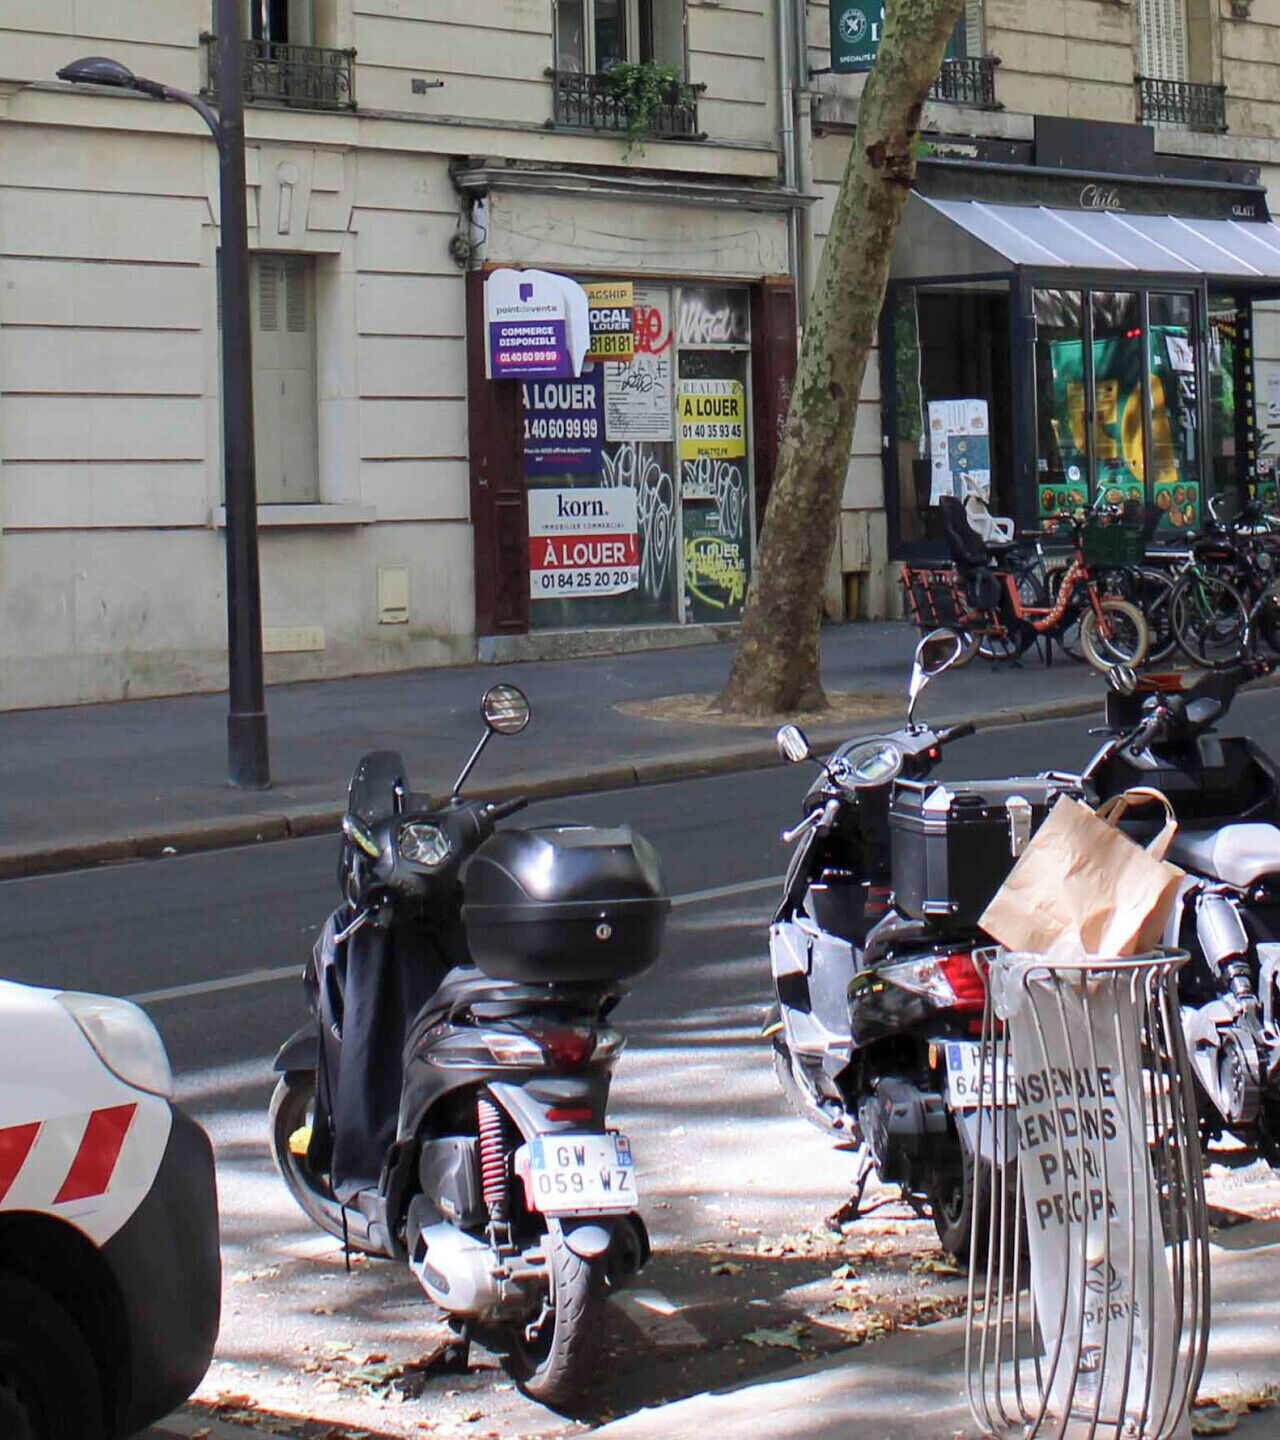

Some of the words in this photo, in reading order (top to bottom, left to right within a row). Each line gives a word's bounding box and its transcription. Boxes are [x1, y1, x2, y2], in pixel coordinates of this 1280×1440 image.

[1232, 204, 1255, 217] GLATT
[589, 290, 627, 300] AGSHIP
[590, 309, 630, 323] OCAL
[501, 326, 554, 337] COMMERCE
[593, 322, 630, 331] LOUER
[499, 337, 557, 347] DISPONIBLE
[534, 384, 596, 410] LOUER
[684, 399, 693, 416] A
[697, 398, 739, 417] LOUER
[531, 419, 547, 439] 40
[548, 419, 564, 439] 60
[566, 418, 581, 439] 99
[583, 418, 598, 438] 99
[682, 425, 692, 438] 01
[695, 425, 705, 438] 40
[707, 425, 718, 437] 35
[719, 425, 730, 437] 93
[731, 425, 742, 438] 45
[556, 493, 609, 517] korn.
[543, 538, 559, 566] À
[562, 542, 626, 566] LOUER
[541, 574, 555, 589] 01
[558, 573, 574, 588] 84
[577, 572, 591, 588] 25
[595, 571, 611, 586] 20
[613, 571, 629, 586] 20
[1016, 1065, 1117, 1107] NSEMBLE
[1039, 1146, 1102, 1186] PARI
